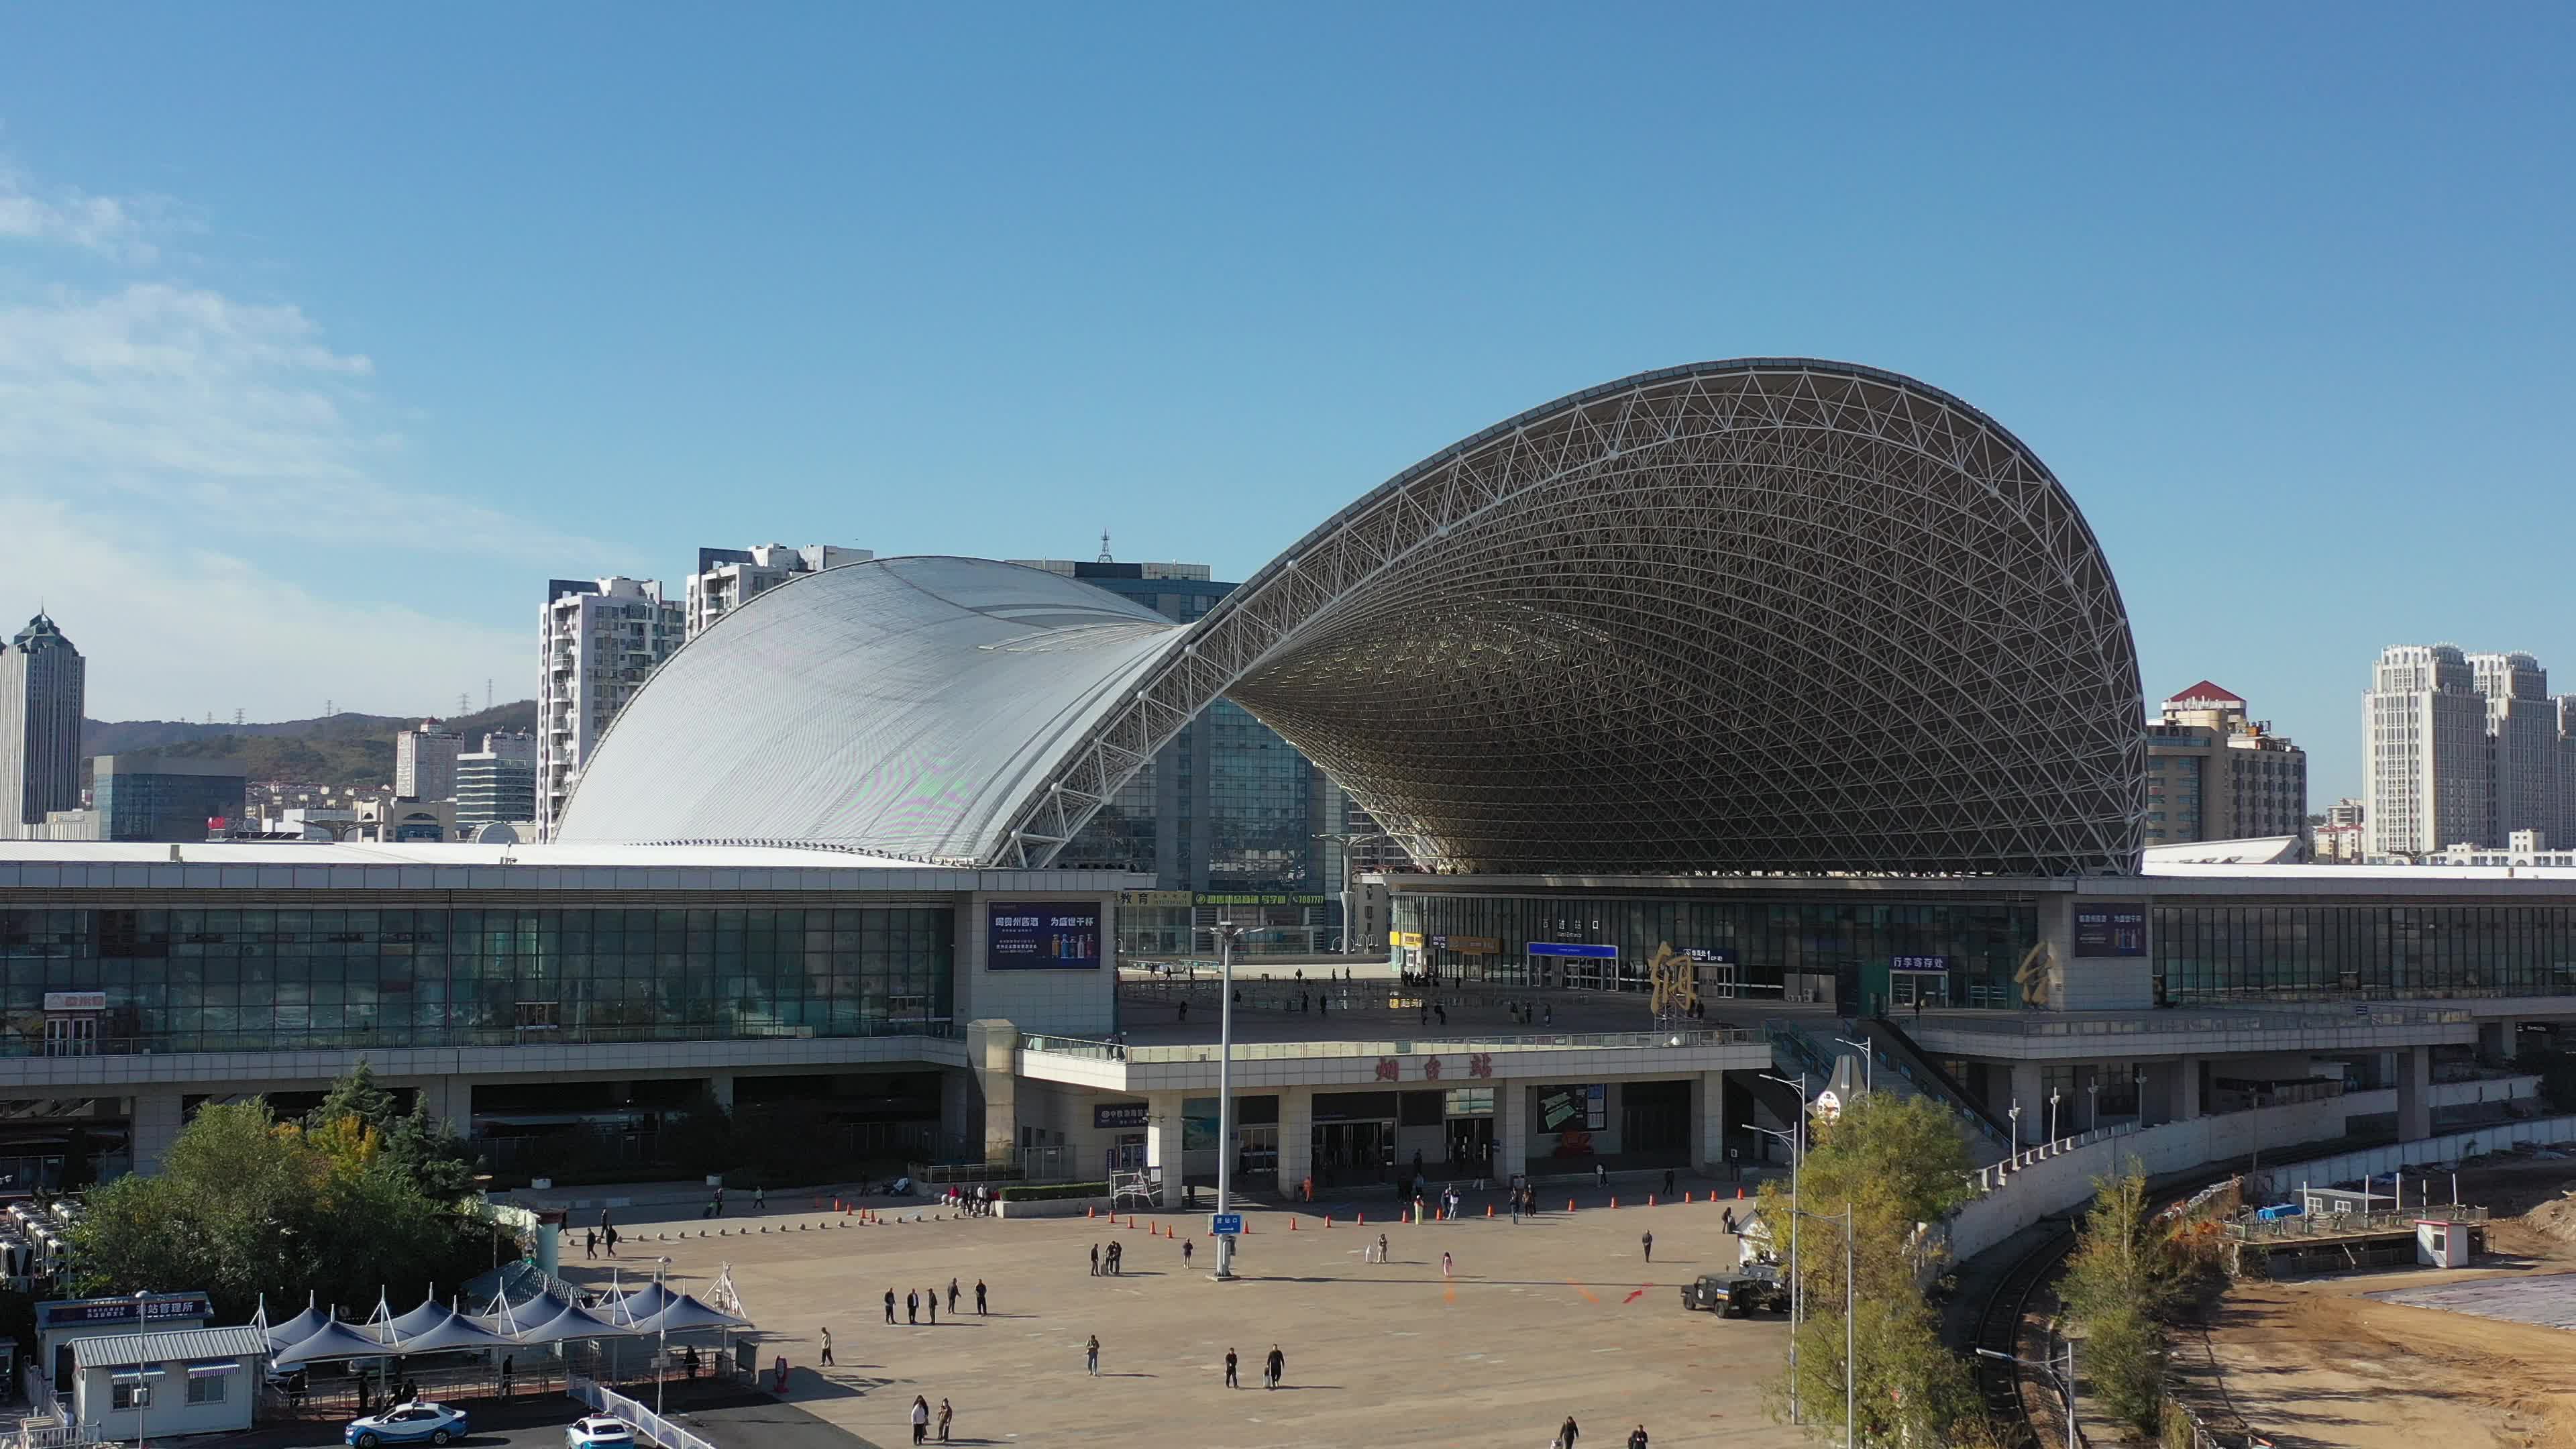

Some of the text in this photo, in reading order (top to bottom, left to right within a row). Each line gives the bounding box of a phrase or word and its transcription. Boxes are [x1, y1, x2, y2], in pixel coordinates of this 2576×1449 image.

[1121, 892, 1149, 905] 教育
[1298, 895, 1324, 904] 7087777
[1051, 917, 1094, 926] 为盛世干杯
[1894, 957, 1943, 968] 行李寄存处
[1375, 1052, 1493, 1082] 烟台站
